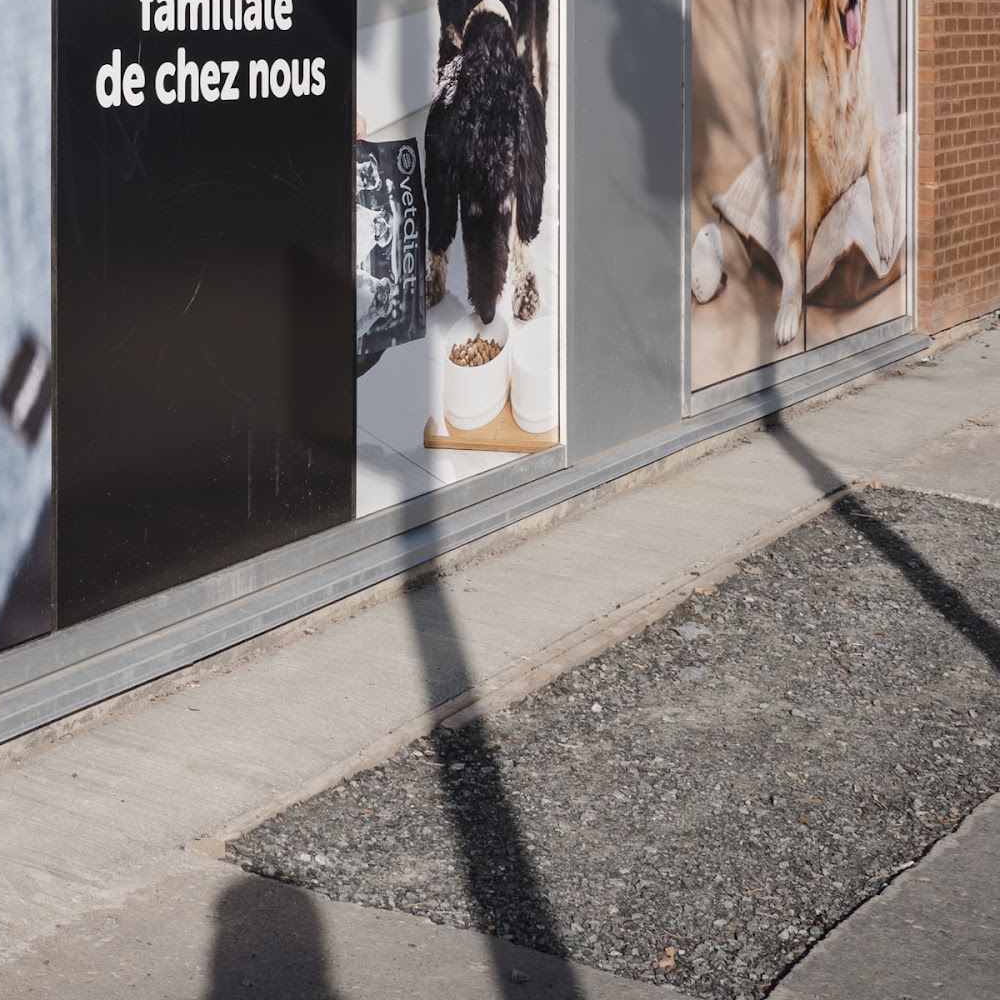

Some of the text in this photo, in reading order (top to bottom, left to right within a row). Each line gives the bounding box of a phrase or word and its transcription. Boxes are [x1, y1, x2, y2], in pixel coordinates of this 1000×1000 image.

[95, 46, 326, 109] de chez nous
[399, 175, 418, 290] vetdiet
